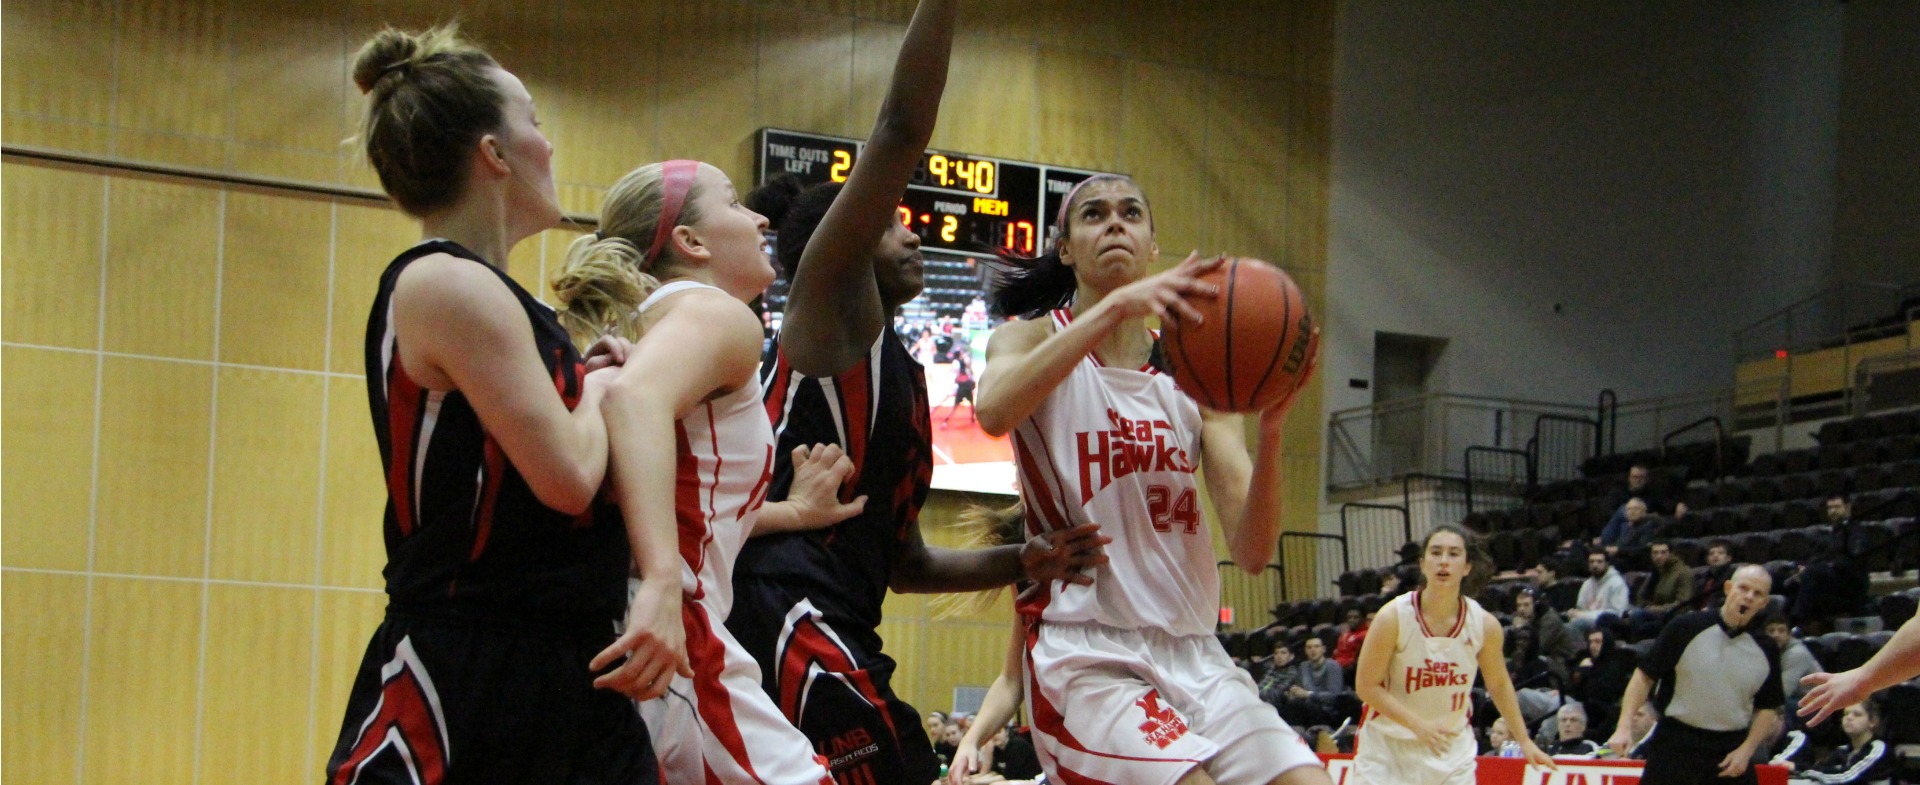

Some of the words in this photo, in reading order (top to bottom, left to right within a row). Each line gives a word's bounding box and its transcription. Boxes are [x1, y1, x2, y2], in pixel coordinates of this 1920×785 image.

[769, 143, 797, 159] TIME
[798, 147, 829, 164] OUTS
[785, 158, 813, 175] LEFT
[831, 150, 851, 183] 2
[929, 154, 995, 194] 9:40
[1047, 179, 1074, 194] TIME
[934, 201, 967, 215] PERIOD
[973, 197, 1009, 217] MEM
[941, 215, 958, 242] 2
[1005, 221, 1034, 252] 17
[1147, 485, 1200, 534] 24
[1423, 658, 1459, 673] Sea-
[1405, 666, 1468, 694] Hawks
[1451, 691, 1466, 712] 11
